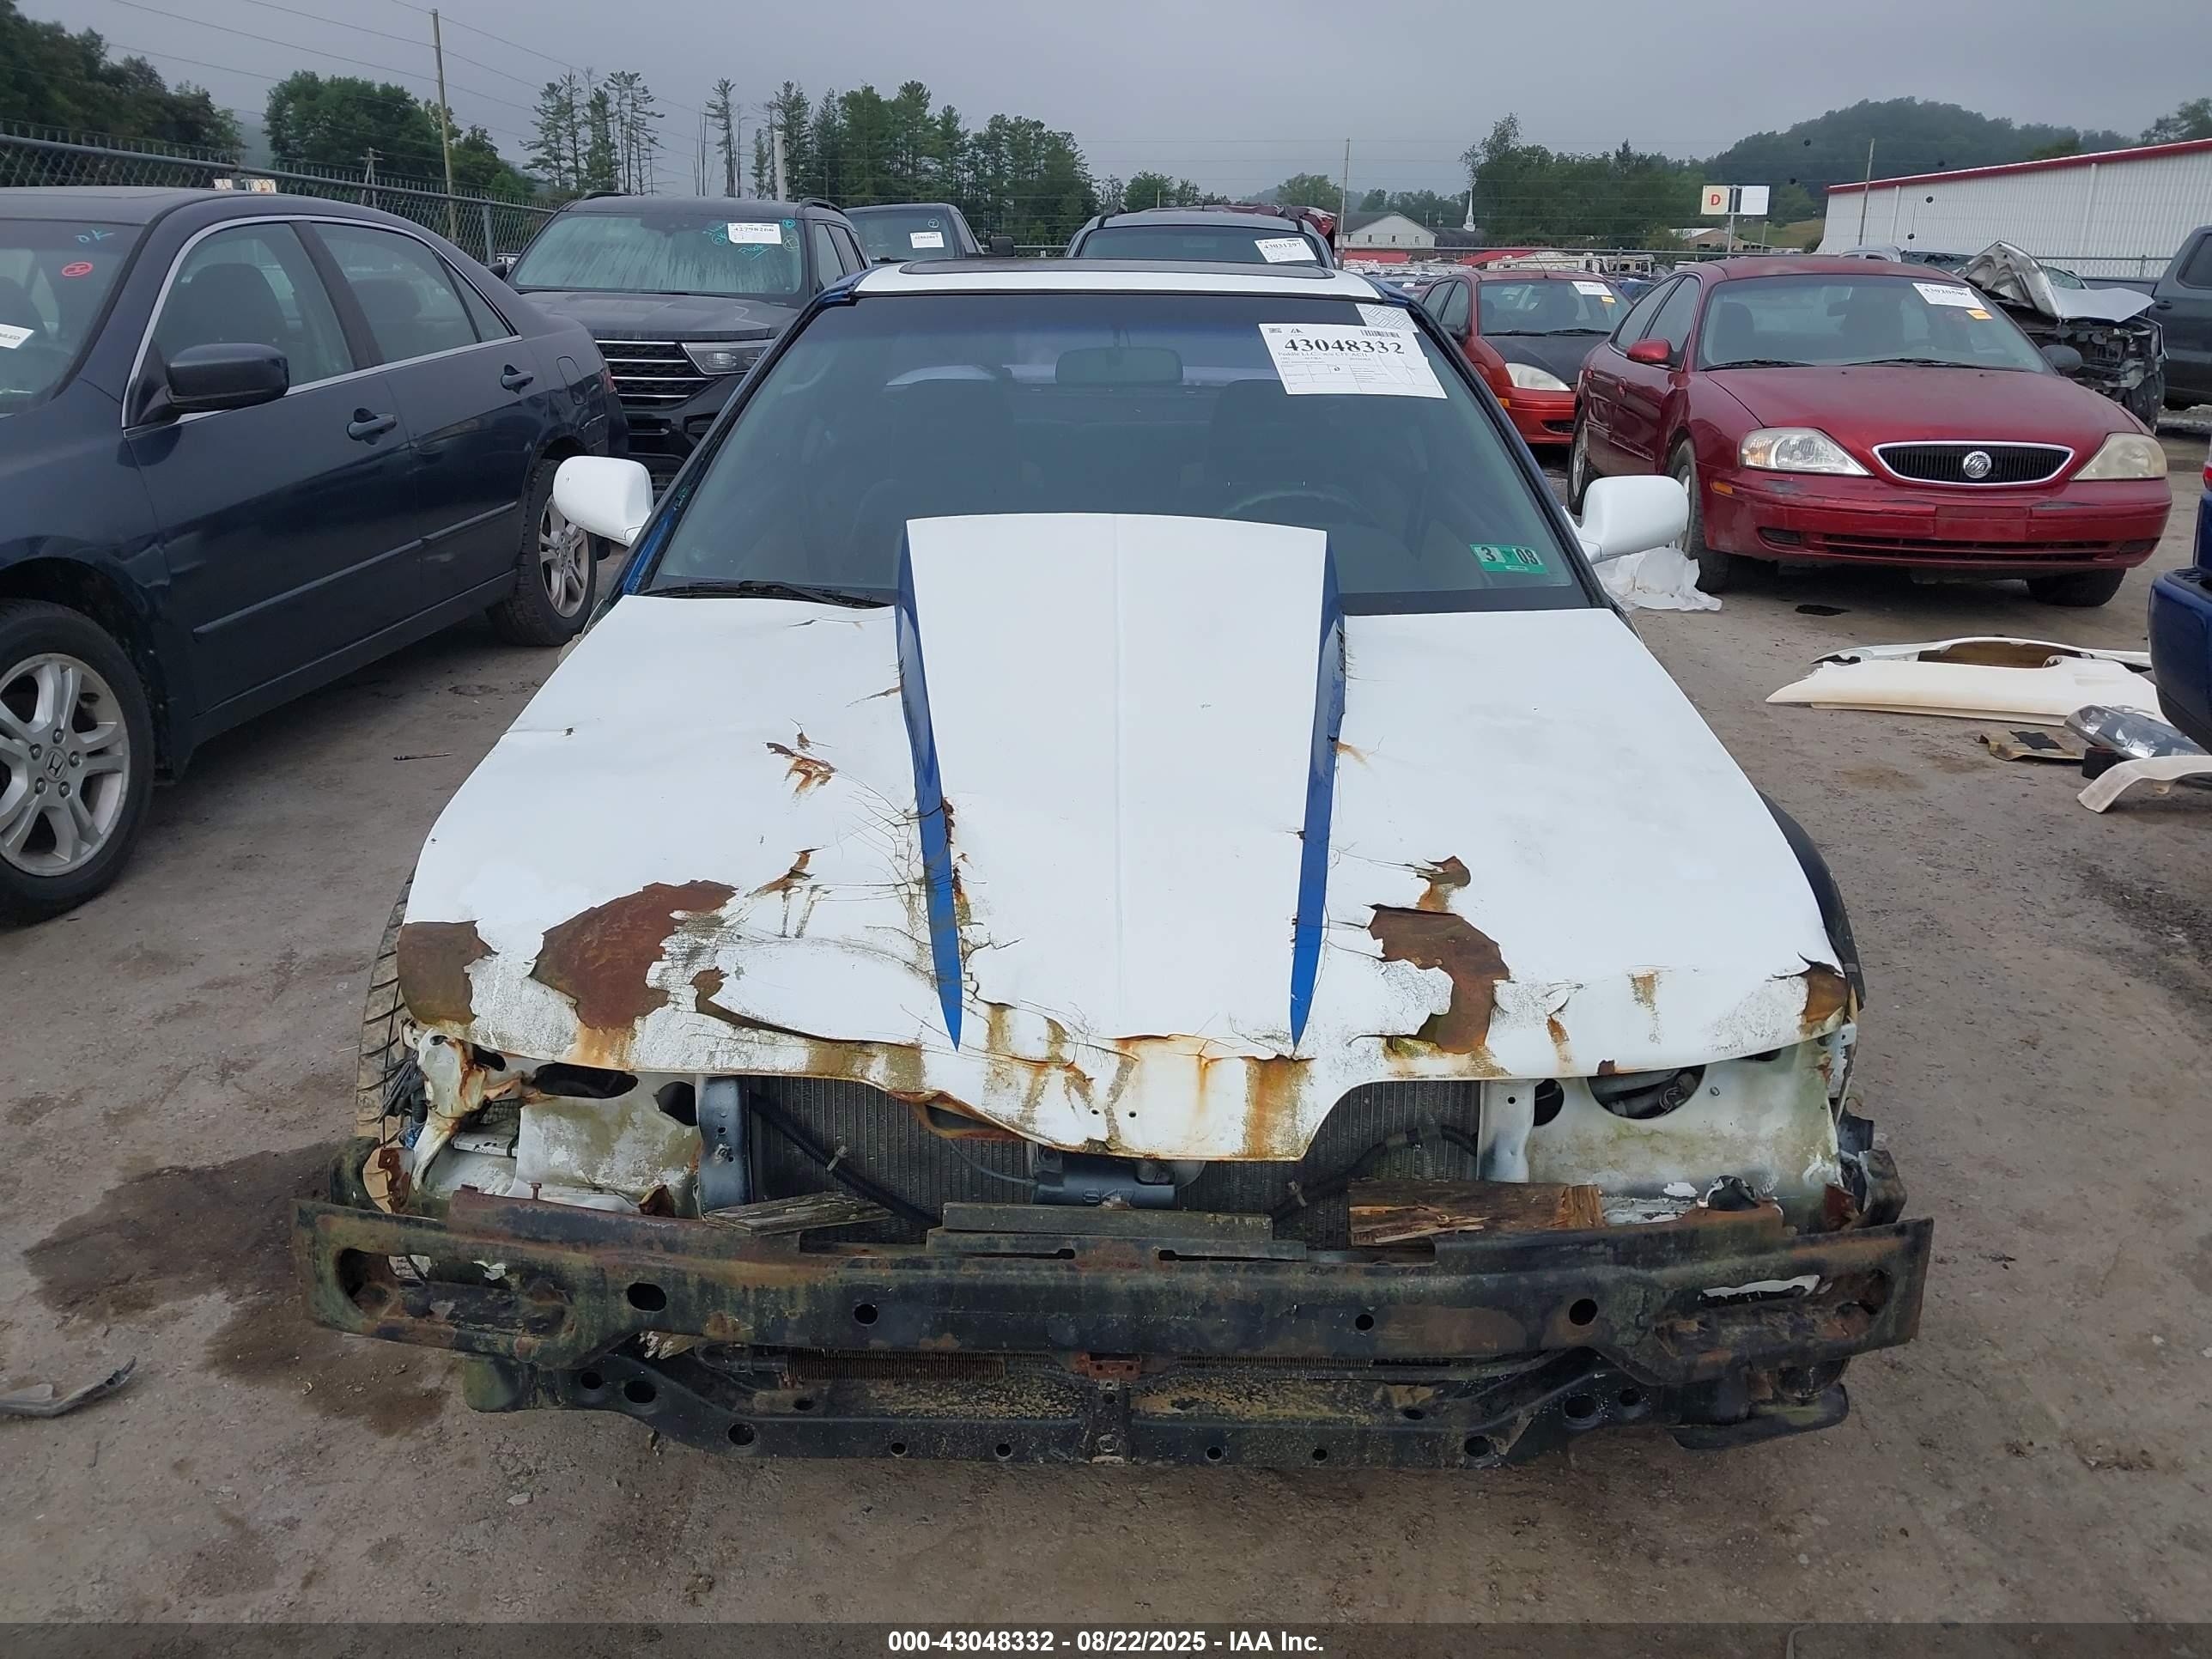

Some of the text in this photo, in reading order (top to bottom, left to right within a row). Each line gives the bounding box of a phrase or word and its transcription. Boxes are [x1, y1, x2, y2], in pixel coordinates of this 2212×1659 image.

[1711, 194, 1721, 205] D
[1285, 339, 1404, 354] 43048332
[1481, 546, 1540, 565] 3 08
